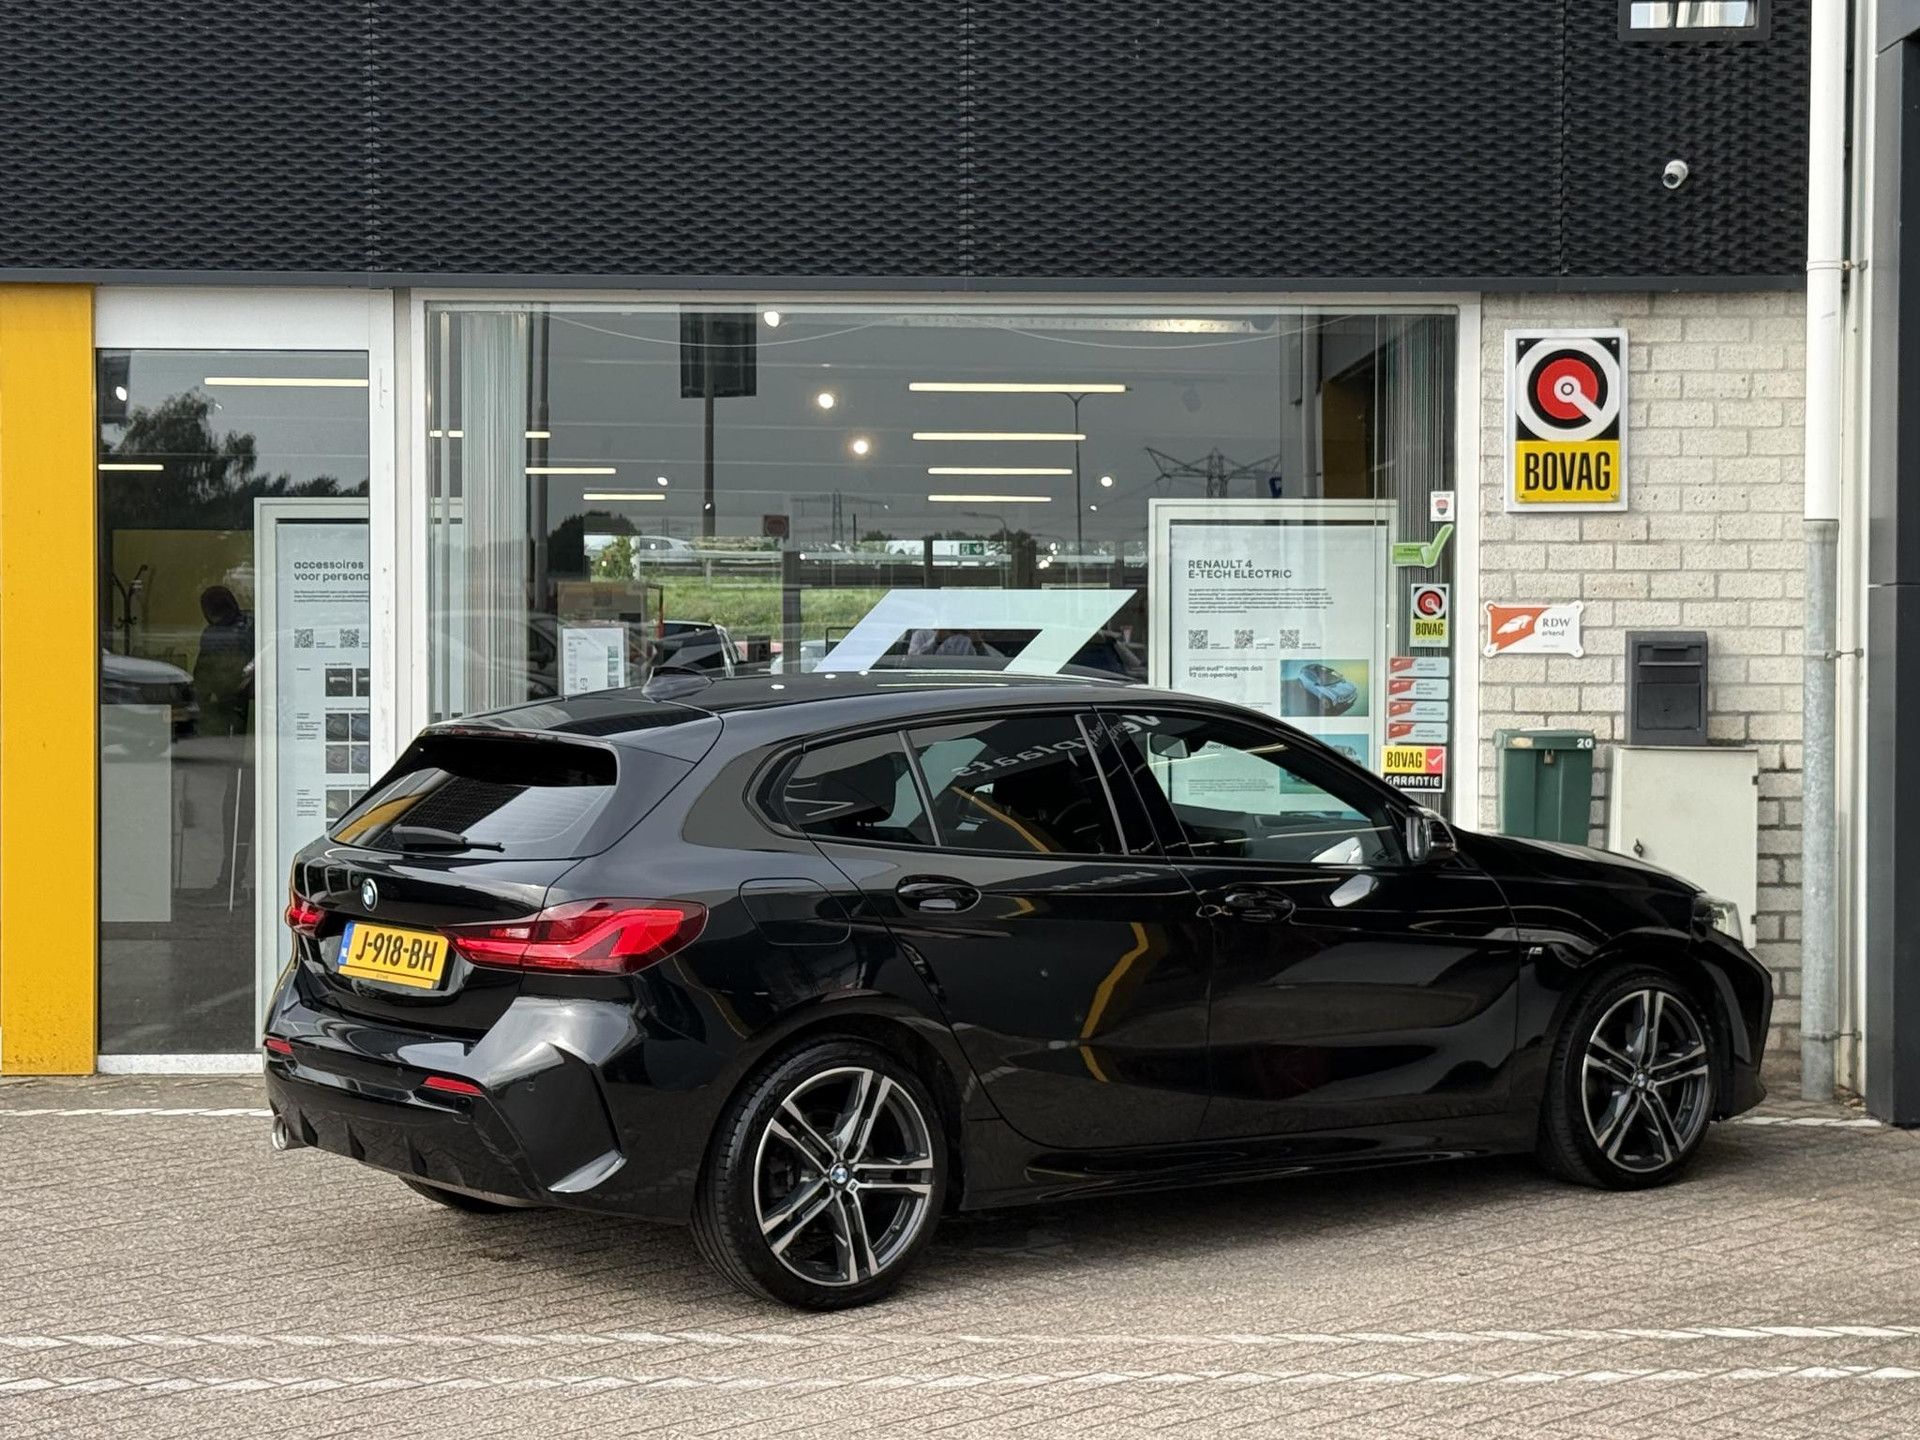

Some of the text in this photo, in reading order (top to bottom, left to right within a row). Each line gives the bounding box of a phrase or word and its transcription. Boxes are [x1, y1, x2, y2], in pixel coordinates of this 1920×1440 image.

[1524, 451, 1611, 491] BOVAG
[294, 560, 364, 570] accessoires
[1188, 560, 1253, 569] RENAULT 4
[294, 573, 320, 581] voor
[1188, 569, 1292, 579] E-TECH ELECTRIC
[1542, 618, 1571, 628] RDW
[1415, 622, 1444, 636] BOVAG
[1576, 738, 1593, 749] 20
[1386, 751, 1423, 768] BOVAG
[1385, 774, 1441, 787] GARANTIE
[354, 930, 439, 973] J-918-BH
